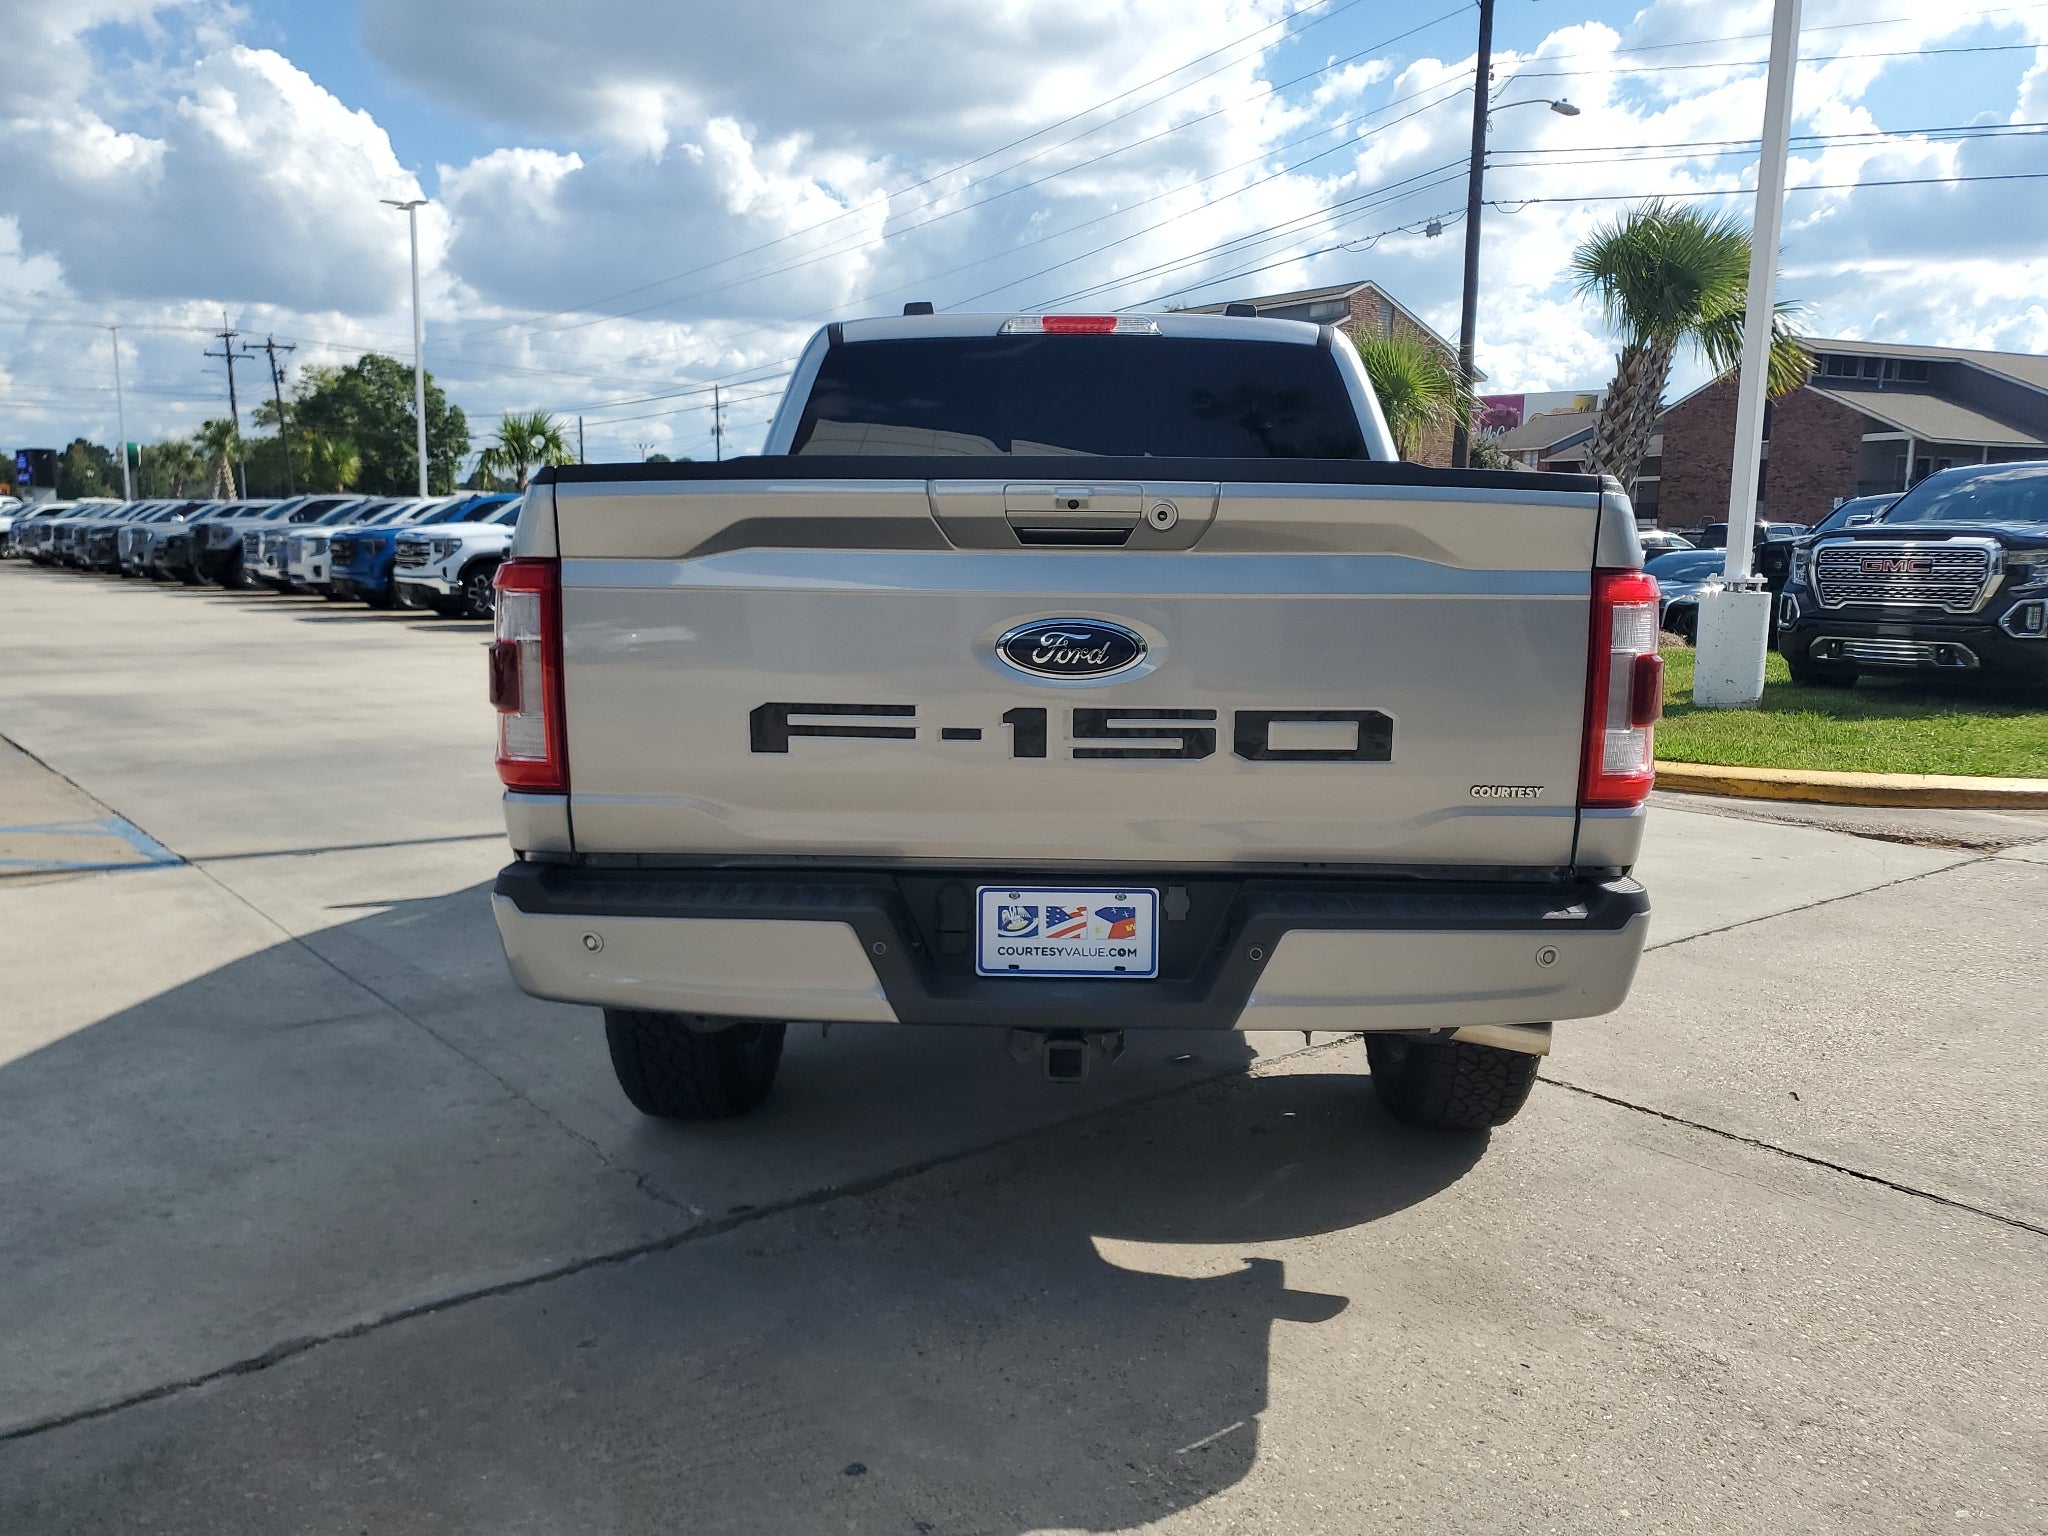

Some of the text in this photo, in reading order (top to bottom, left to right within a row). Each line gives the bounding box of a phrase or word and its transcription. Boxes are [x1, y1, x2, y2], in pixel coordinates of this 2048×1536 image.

[1861, 559, 1932, 573] GMC
[1032, 631, 1112, 664] Ford
[750, 702, 1394, 762] F-150
[1470, 784, 1544, 798] COURTESY
[997, 946, 1138, 958] COURTESYVALUE.COM
